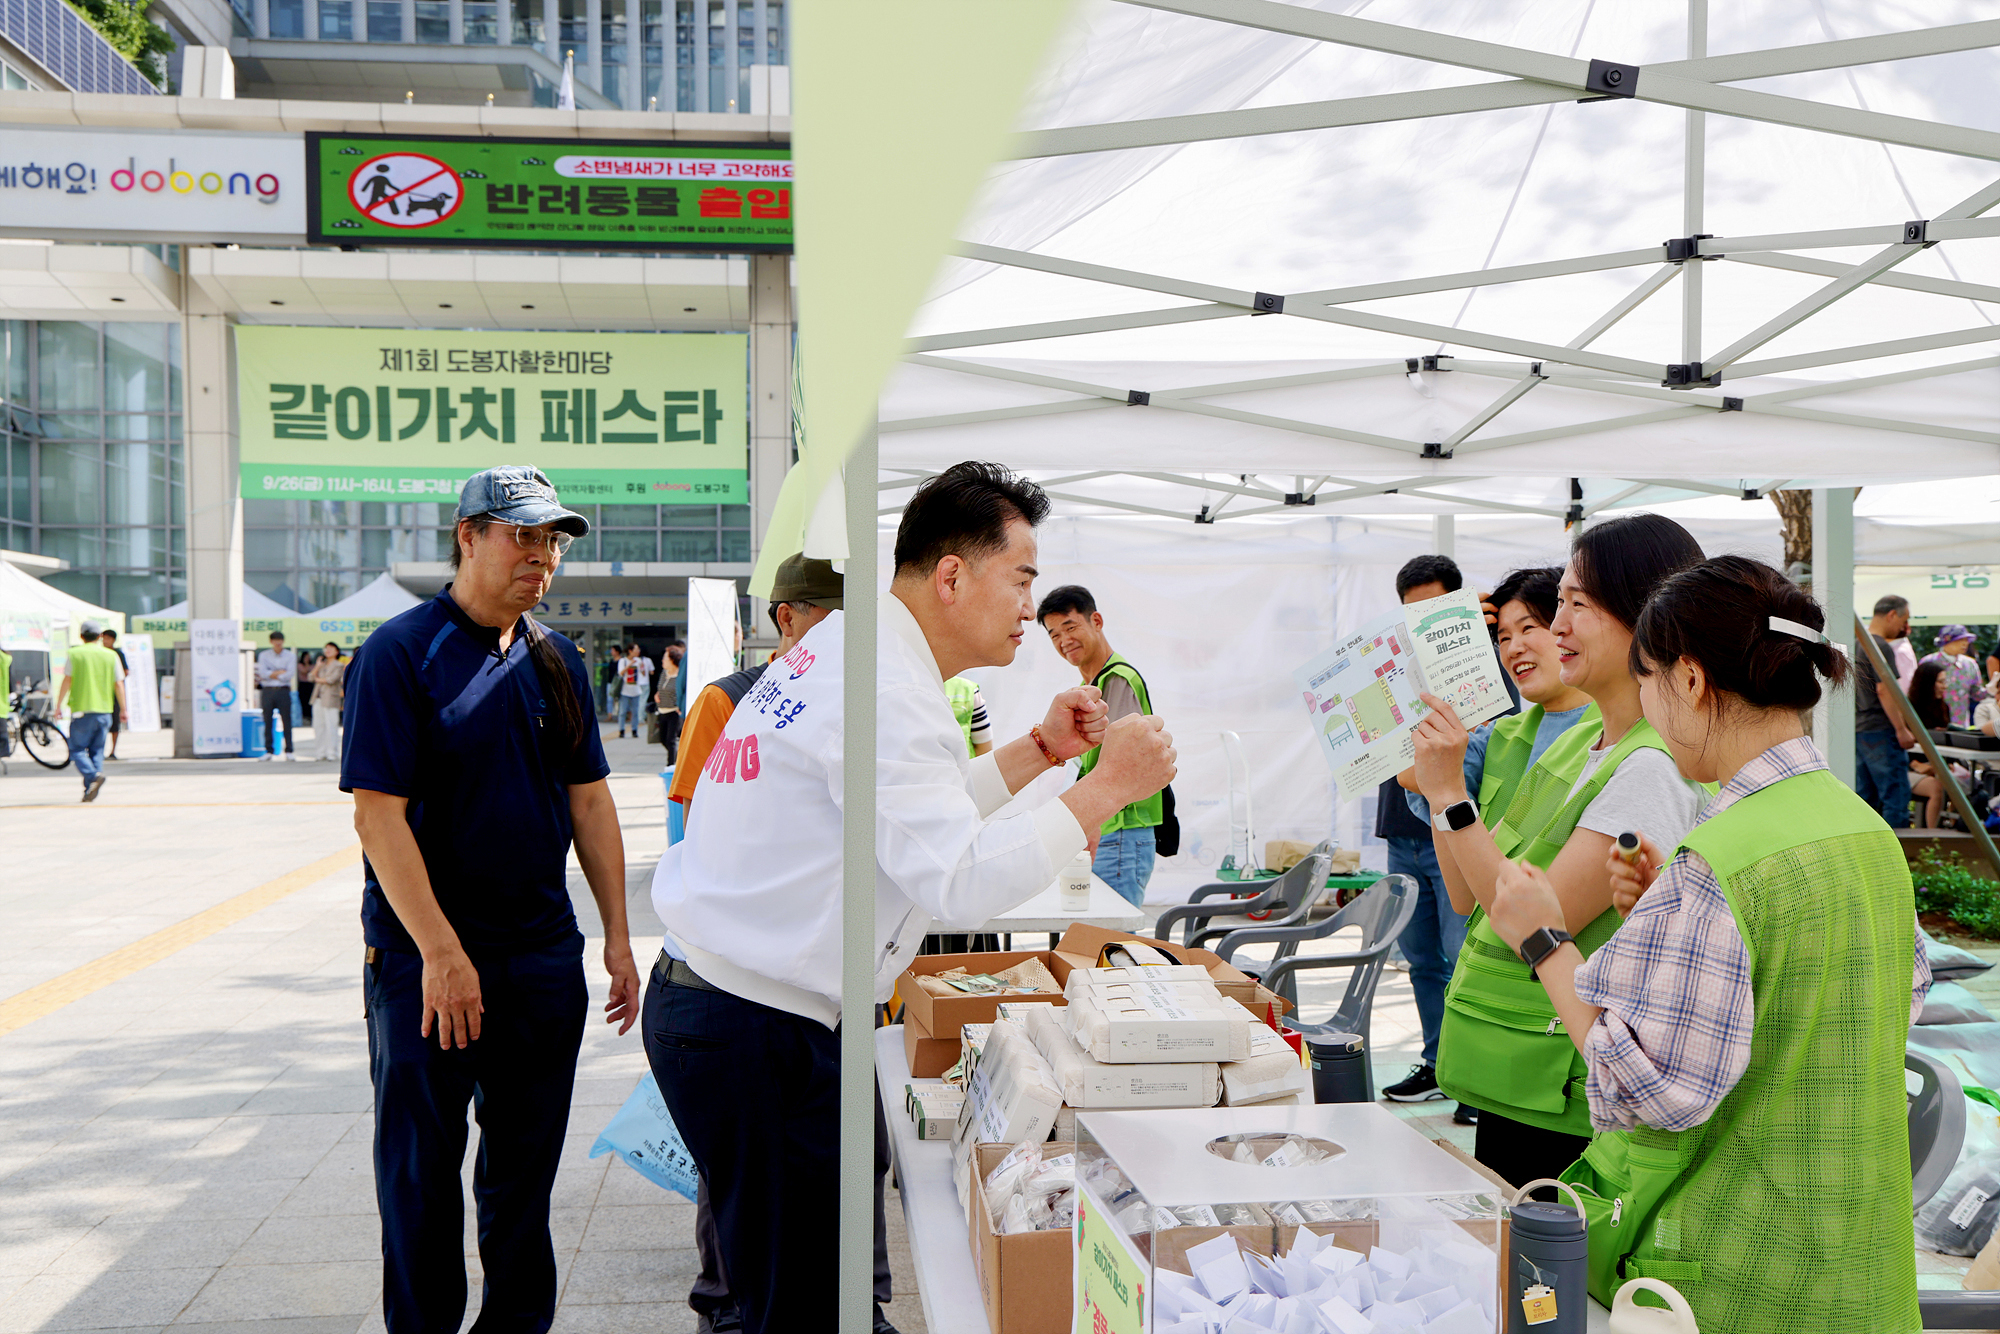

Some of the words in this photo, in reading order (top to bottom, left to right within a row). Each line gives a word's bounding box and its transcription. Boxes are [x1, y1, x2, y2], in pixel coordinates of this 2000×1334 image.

[678, 162, 716, 177] 너무
[110, 156, 280, 205] dobong
[486, 183, 680, 217] 반려동물
[698, 186, 790, 219] 출입
[379, 347, 438, 373] 제1회
[446, 348, 613, 375] 도봉자활한마당
[269, 382, 516, 444] 같이가치
[540, 388, 724, 446] 페스타
[262, 475, 324, 492] 9/26(금)
[397, 478, 452, 495] 도봉구청
[626, 482, 646, 494] 후원
[652, 481, 691, 492] dobong
[694, 483, 730, 494] 도봉구청
[558, 601, 633, 617] 도봉구청
[320, 620, 355, 633] GS25
[1424, 620, 1471, 643] 같이가치
[1435, 635, 1471, 655] 페스타
[772, 698, 807, 730] 도봉
